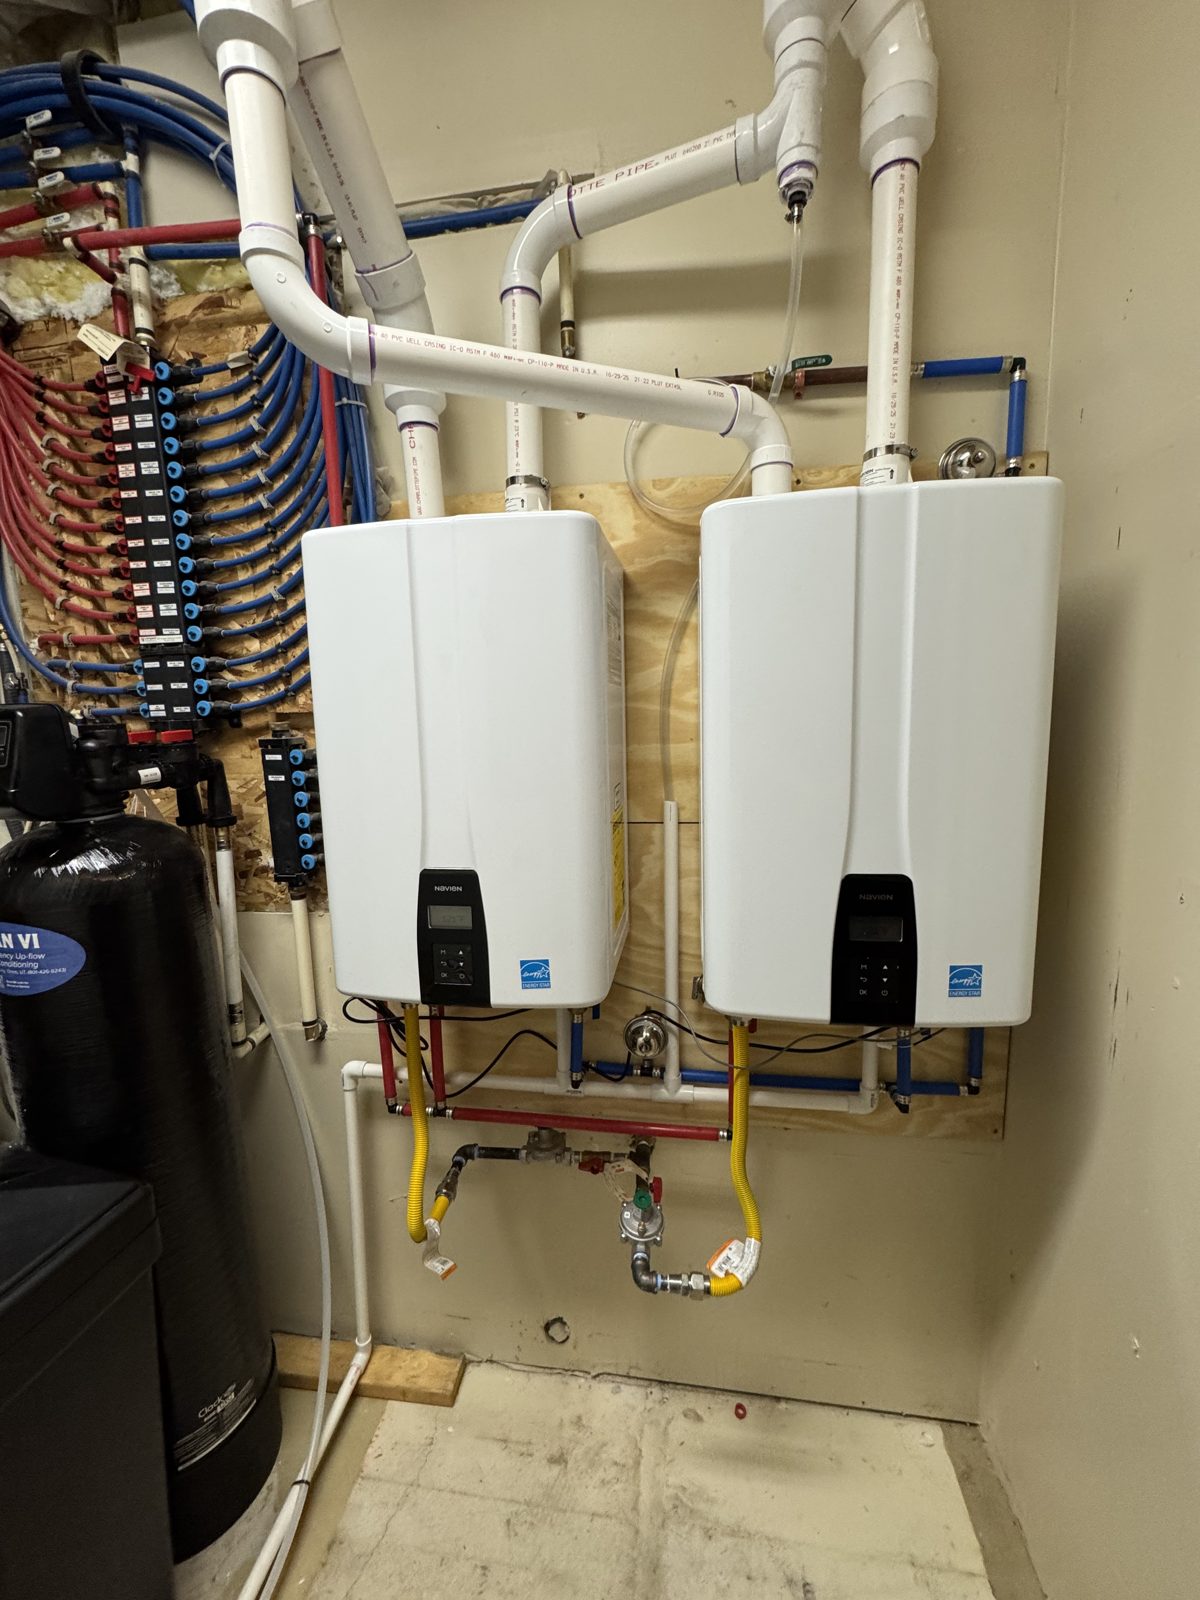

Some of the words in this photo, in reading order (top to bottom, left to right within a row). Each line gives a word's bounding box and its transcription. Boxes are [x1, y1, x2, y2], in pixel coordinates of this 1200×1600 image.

[391, 334, 404, 343] PVC
[406, 336, 421, 346] WELL
[424, 340, 447, 350] CASING
[466, 347, 481, 355] ASTM
[490, 351, 501, 360] 480
[527, 358, 554, 368] CP-110-P
[556, 363, 570, 371] MADE
[17, 933, 41, 950] VI
